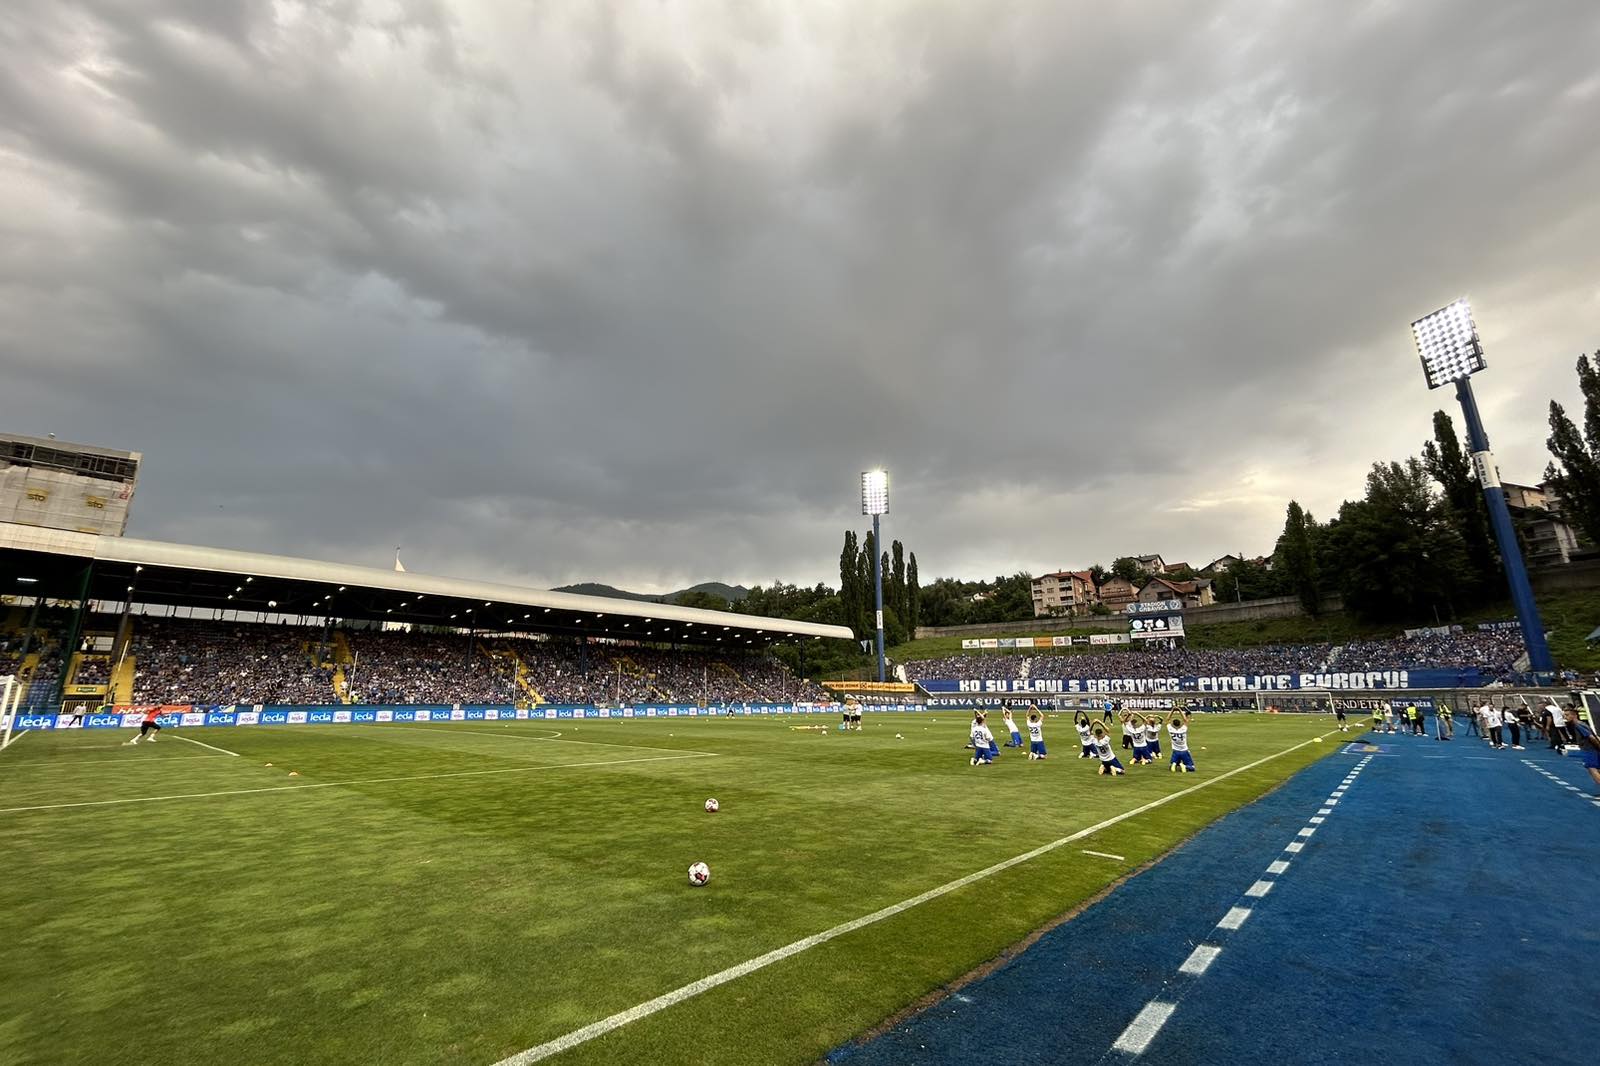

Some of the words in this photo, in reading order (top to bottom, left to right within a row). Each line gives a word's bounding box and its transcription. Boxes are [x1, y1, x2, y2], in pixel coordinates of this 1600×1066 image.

[959, 679, 980, 692] KO
[985, 679, 1007, 692] SU
[1012, 679, 1063, 692] PLAVI
[1068, 679, 1080, 692] S
[1086, 678, 1180, 692] GRBAVICE
[1198, 676, 1292, 691] PITAJTE
[1299, 671, 1408, 689] EUROPU!
[931, 698, 973, 706] CURVA
[975, 697, 1001, 706] SUD
[154, 712, 178, 725] eda
[262, 712, 285, 722] leda
[310, 712, 331, 721] leda
[354, 711, 374, 720] leda
[395, 711, 413, 720] leda
[433, 710, 450, 719] leda
[467, 711, 483, 719] leda
[500, 710, 515, 718] leda
[530, 710, 545, 718] leda
[19, 716, 52, 728] leda
[88, 715, 118, 726] leda
[208, 714, 234, 724] leda
[1171, 731, 1184, 741] 24
